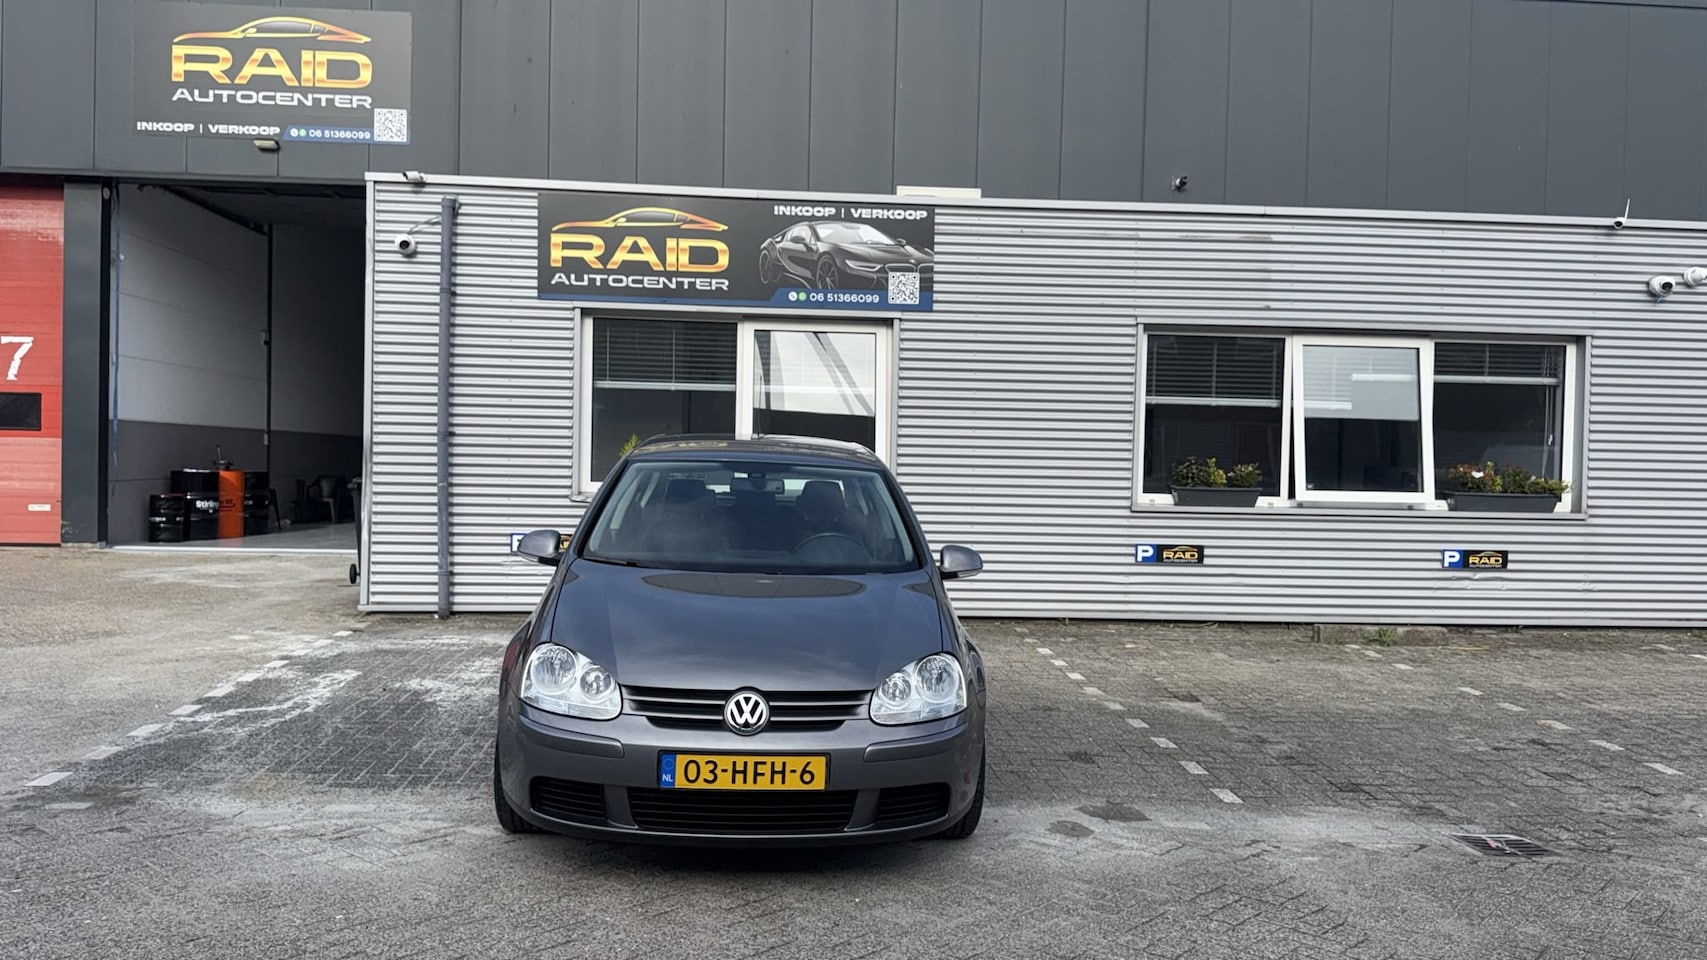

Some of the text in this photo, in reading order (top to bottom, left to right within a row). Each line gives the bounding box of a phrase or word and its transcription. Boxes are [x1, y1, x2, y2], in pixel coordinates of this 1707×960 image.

[171, 44, 373, 89] RAID
[172, 88, 373, 109] AUTOCENTER
[136, 121, 195, 132] INKOOP
[208, 124, 281, 135] VERKOOP
[308, 129, 322, 138] 06
[774, 205, 836, 217] INKOOP
[850, 208, 928, 220] VERKOOP
[550, 233, 730, 273] RAID
[551, 272, 730, 291] AUTOCENTER
[809, 293, 880, 304] 06 51366099
[0, 336, 34, 381] 7
[1137, 545, 1154, 562] P
[1163, 551, 1199, 560] RAID
[1444, 551, 1460, 567] P
[1469, 557, 1503, 565] RAID
[662, 759, 815, 785] NL 03-HFH-6
